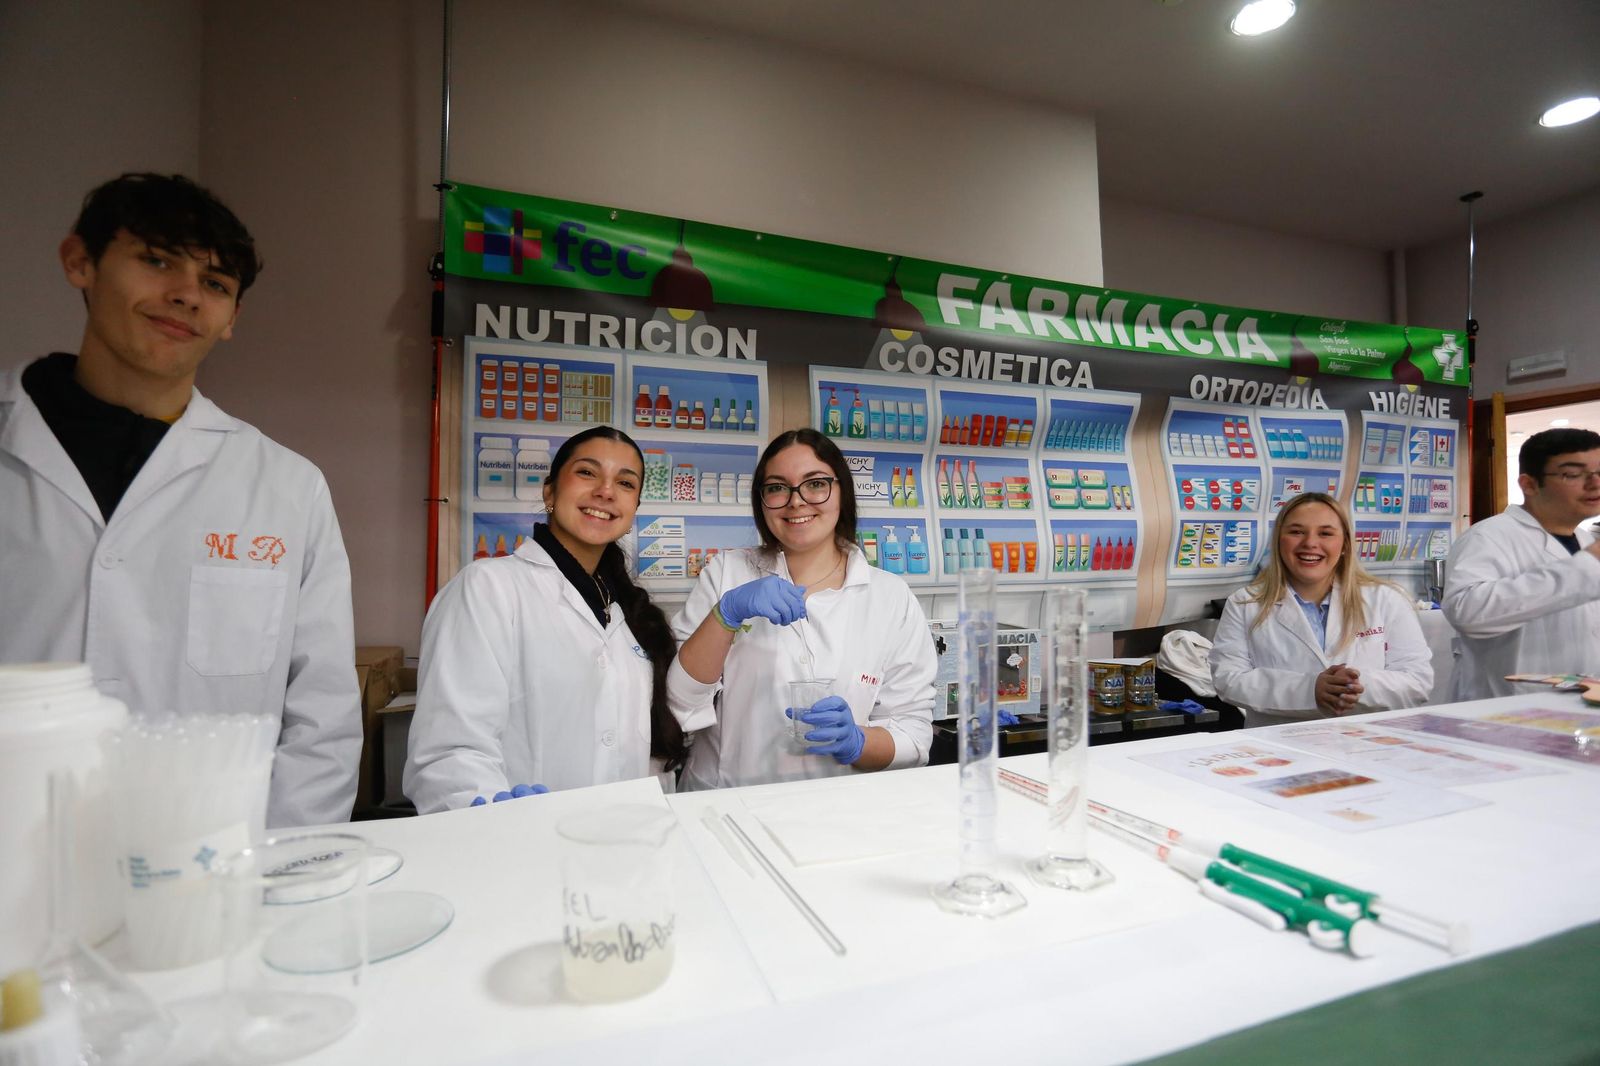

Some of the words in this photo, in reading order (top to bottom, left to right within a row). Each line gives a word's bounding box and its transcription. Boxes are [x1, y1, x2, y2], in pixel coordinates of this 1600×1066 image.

[553, 221, 648, 280] fec
[936, 273, 1280, 362] FARMACIA
[475, 303, 758, 361] NUTRICION
[1319, 335, 1334, 344] San
[1324, 345, 1350, 356] Virgen
[1350, 347, 1358, 355] de
[1359, 348, 1366, 356] la
[879, 341, 1095, 390] COSMETICA
[1189, 374, 1331, 411] ORTOPEDIA
[1368, 391, 1451, 419] HIGIENE
[480, 461, 511, 469] Nutribén
[518, 462, 548, 471] Nutribén
[856, 483, 881, 491] VICHY
